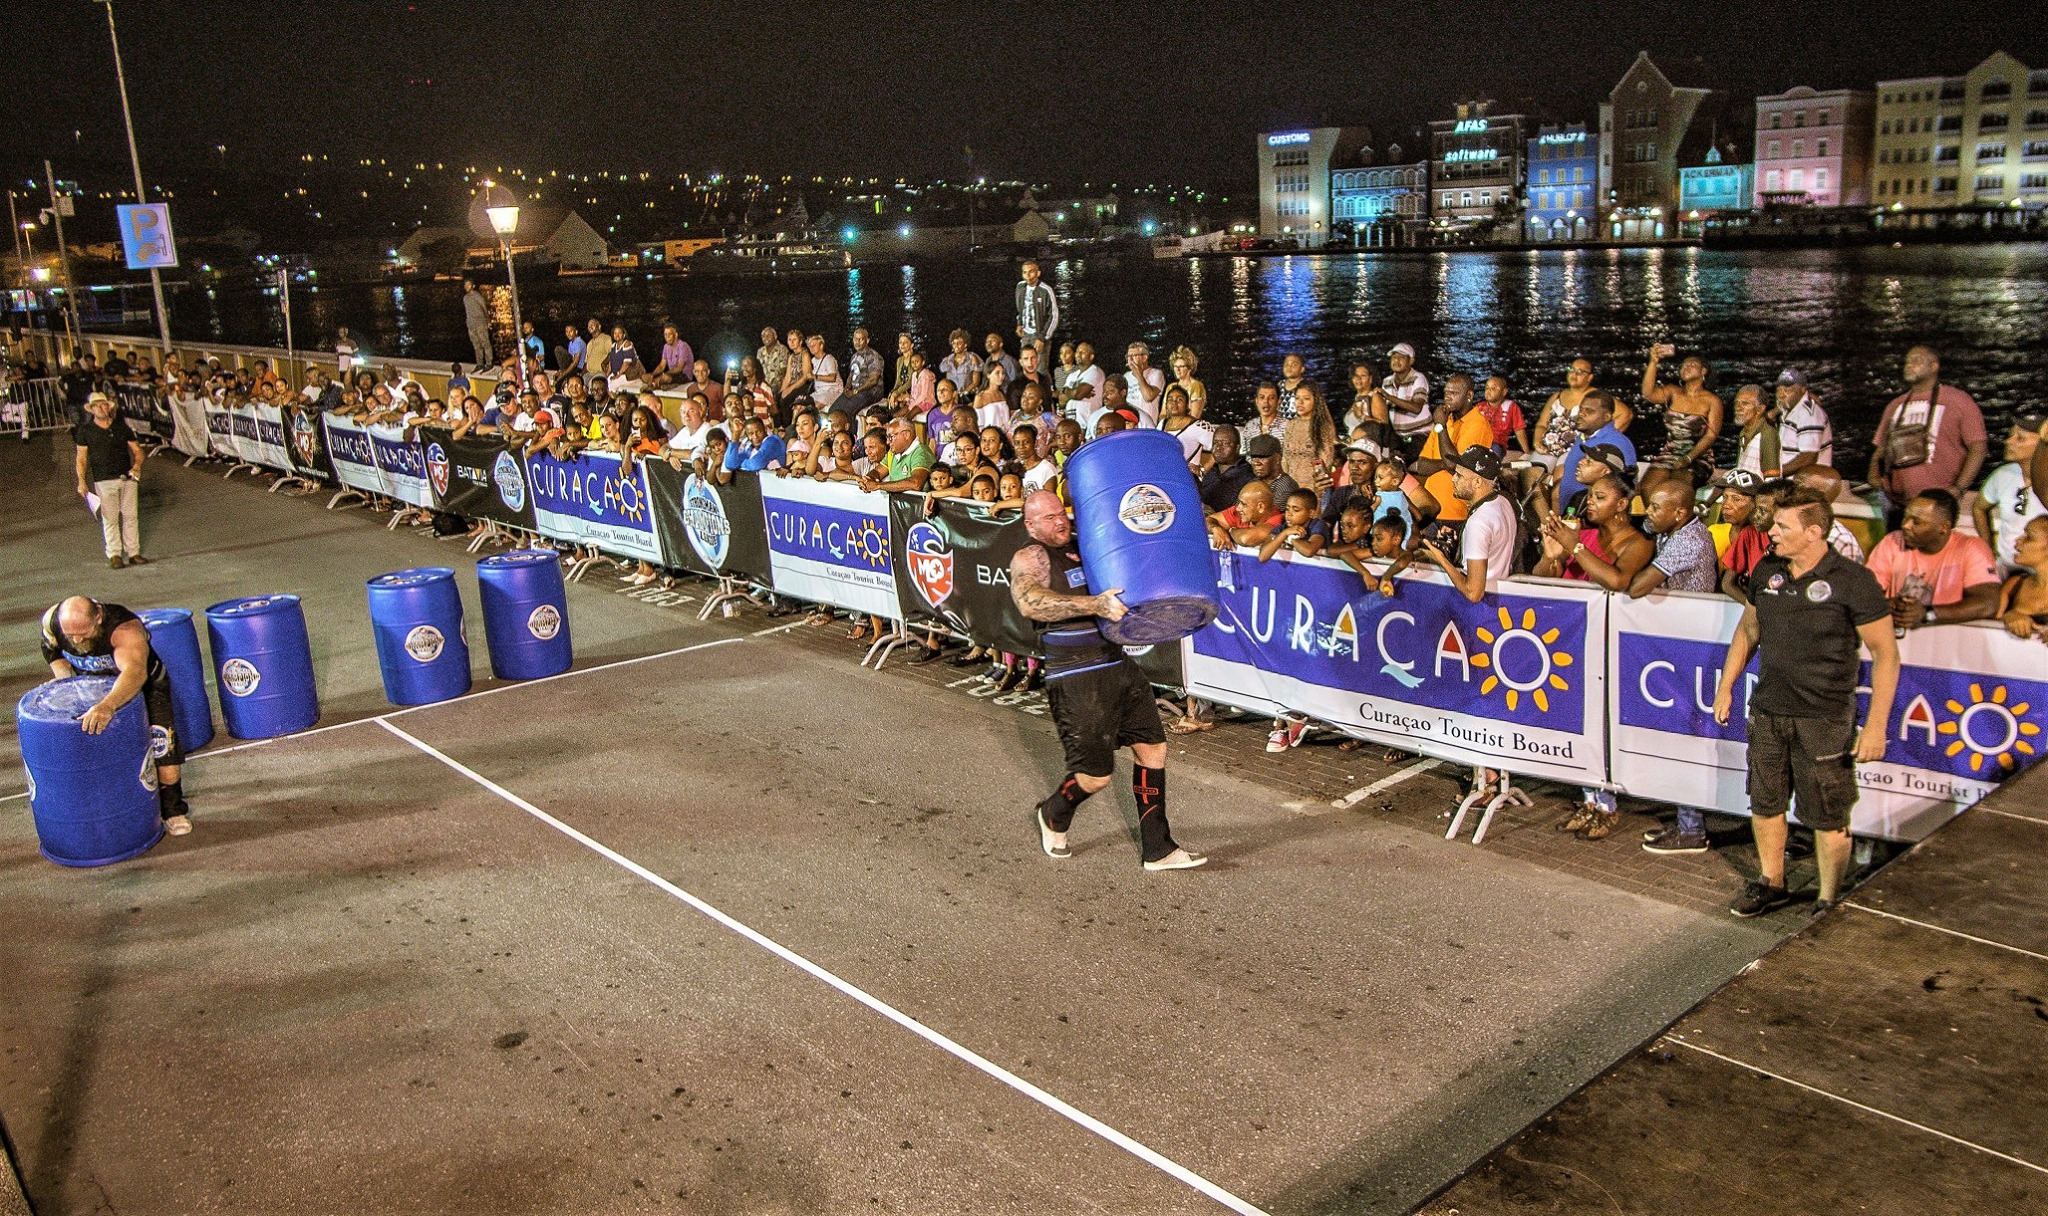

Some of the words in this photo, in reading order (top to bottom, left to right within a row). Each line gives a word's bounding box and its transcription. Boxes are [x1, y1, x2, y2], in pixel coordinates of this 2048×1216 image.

[1268, 132, 1310, 145] CUSTOMS
[1454, 119, 1488, 133] AFAS
[1445, 148, 1498, 162] software
[130, 208, 159, 241] P
[1213, 586, 1551, 691] URAÇAO
[1359, 702, 1431, 732] Curaçao
[1438, 717, 1505, 748] Tourist
[1513, 732, 1574, 759] Board
[1902, 771, 1970, 799] Tourist
